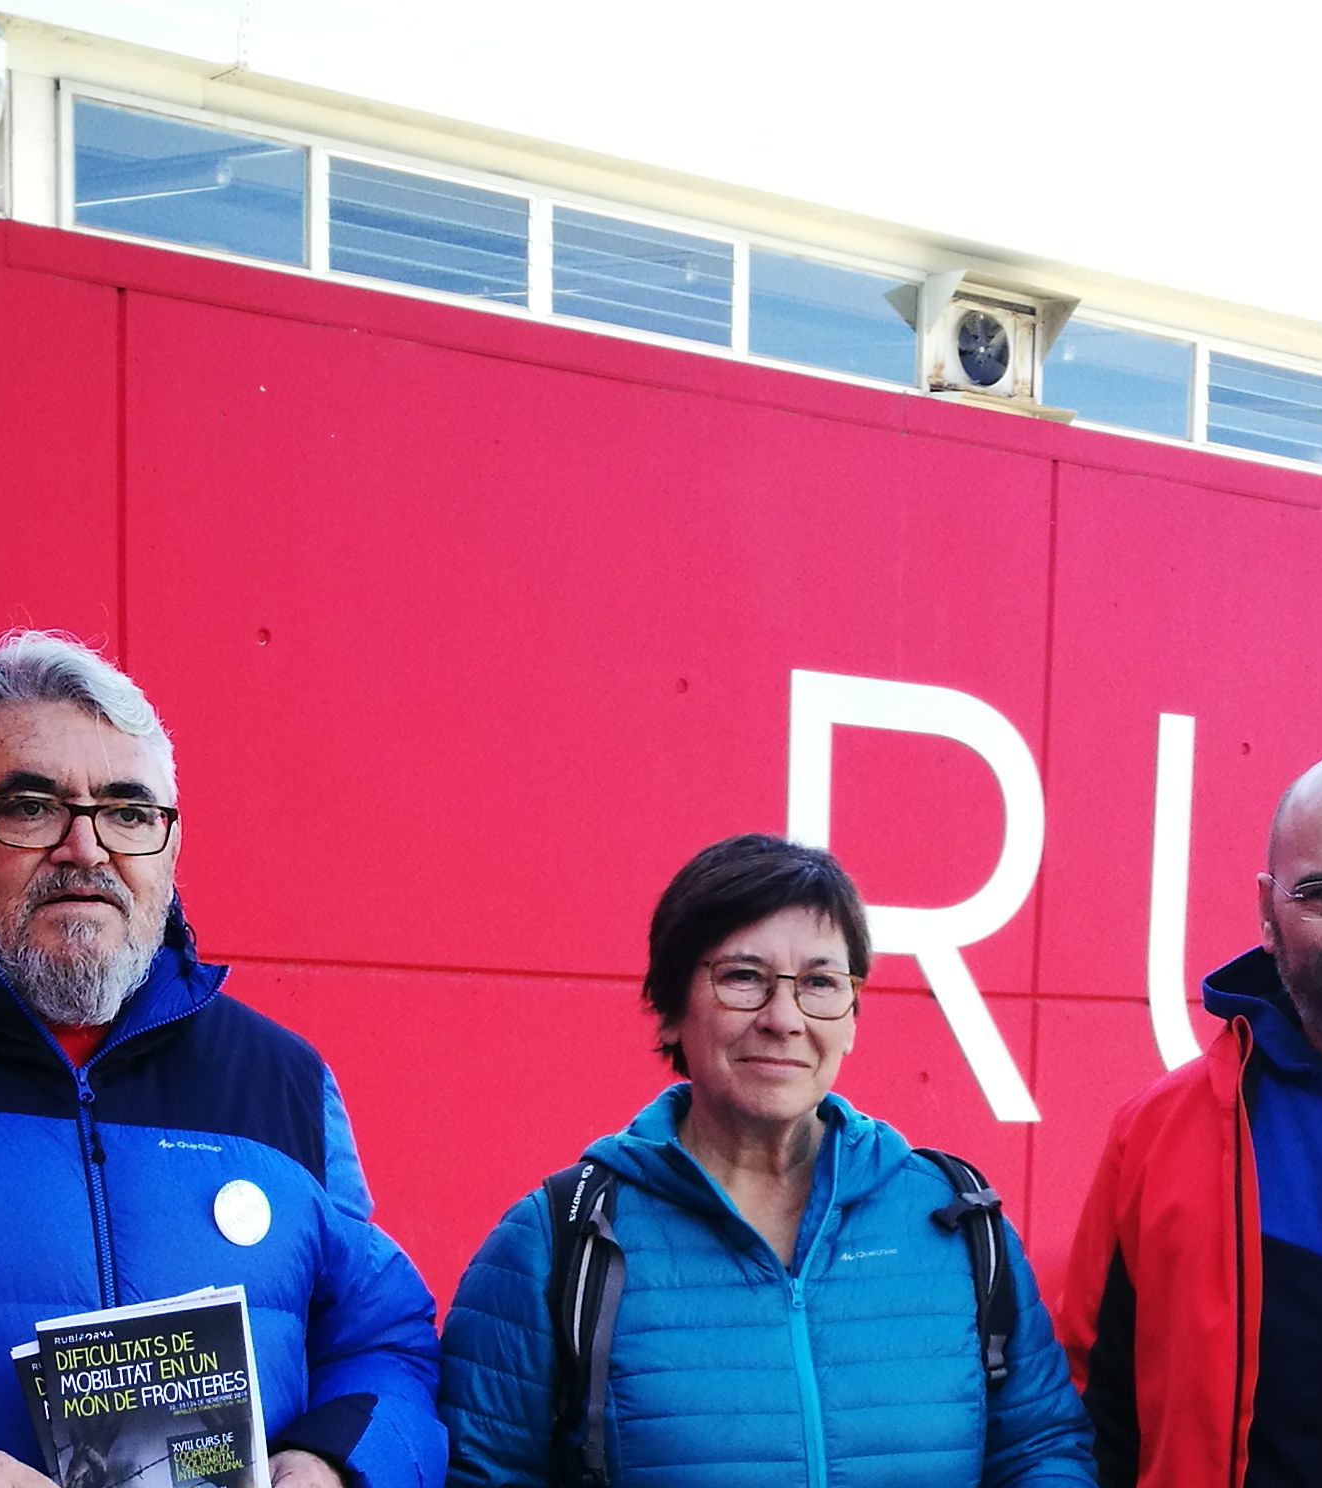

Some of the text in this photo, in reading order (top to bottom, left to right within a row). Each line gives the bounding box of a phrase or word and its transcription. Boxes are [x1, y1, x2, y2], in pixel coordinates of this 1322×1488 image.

[55, 1330, 196, 1371] DIFICULTATS DE
[60, 1361, 154, 1396] MOBILITAT
[159, 1357, 186, 1380] EN
[190, 1351, 218, 1373] UN
[64, 1392, 111, 1419] MÓN
[115, 1389, 138, 1412] DE
[141, 1370, 248, 1407] FRONTERES
[172, 1432, 234, 1452] XVIII CURS DE
